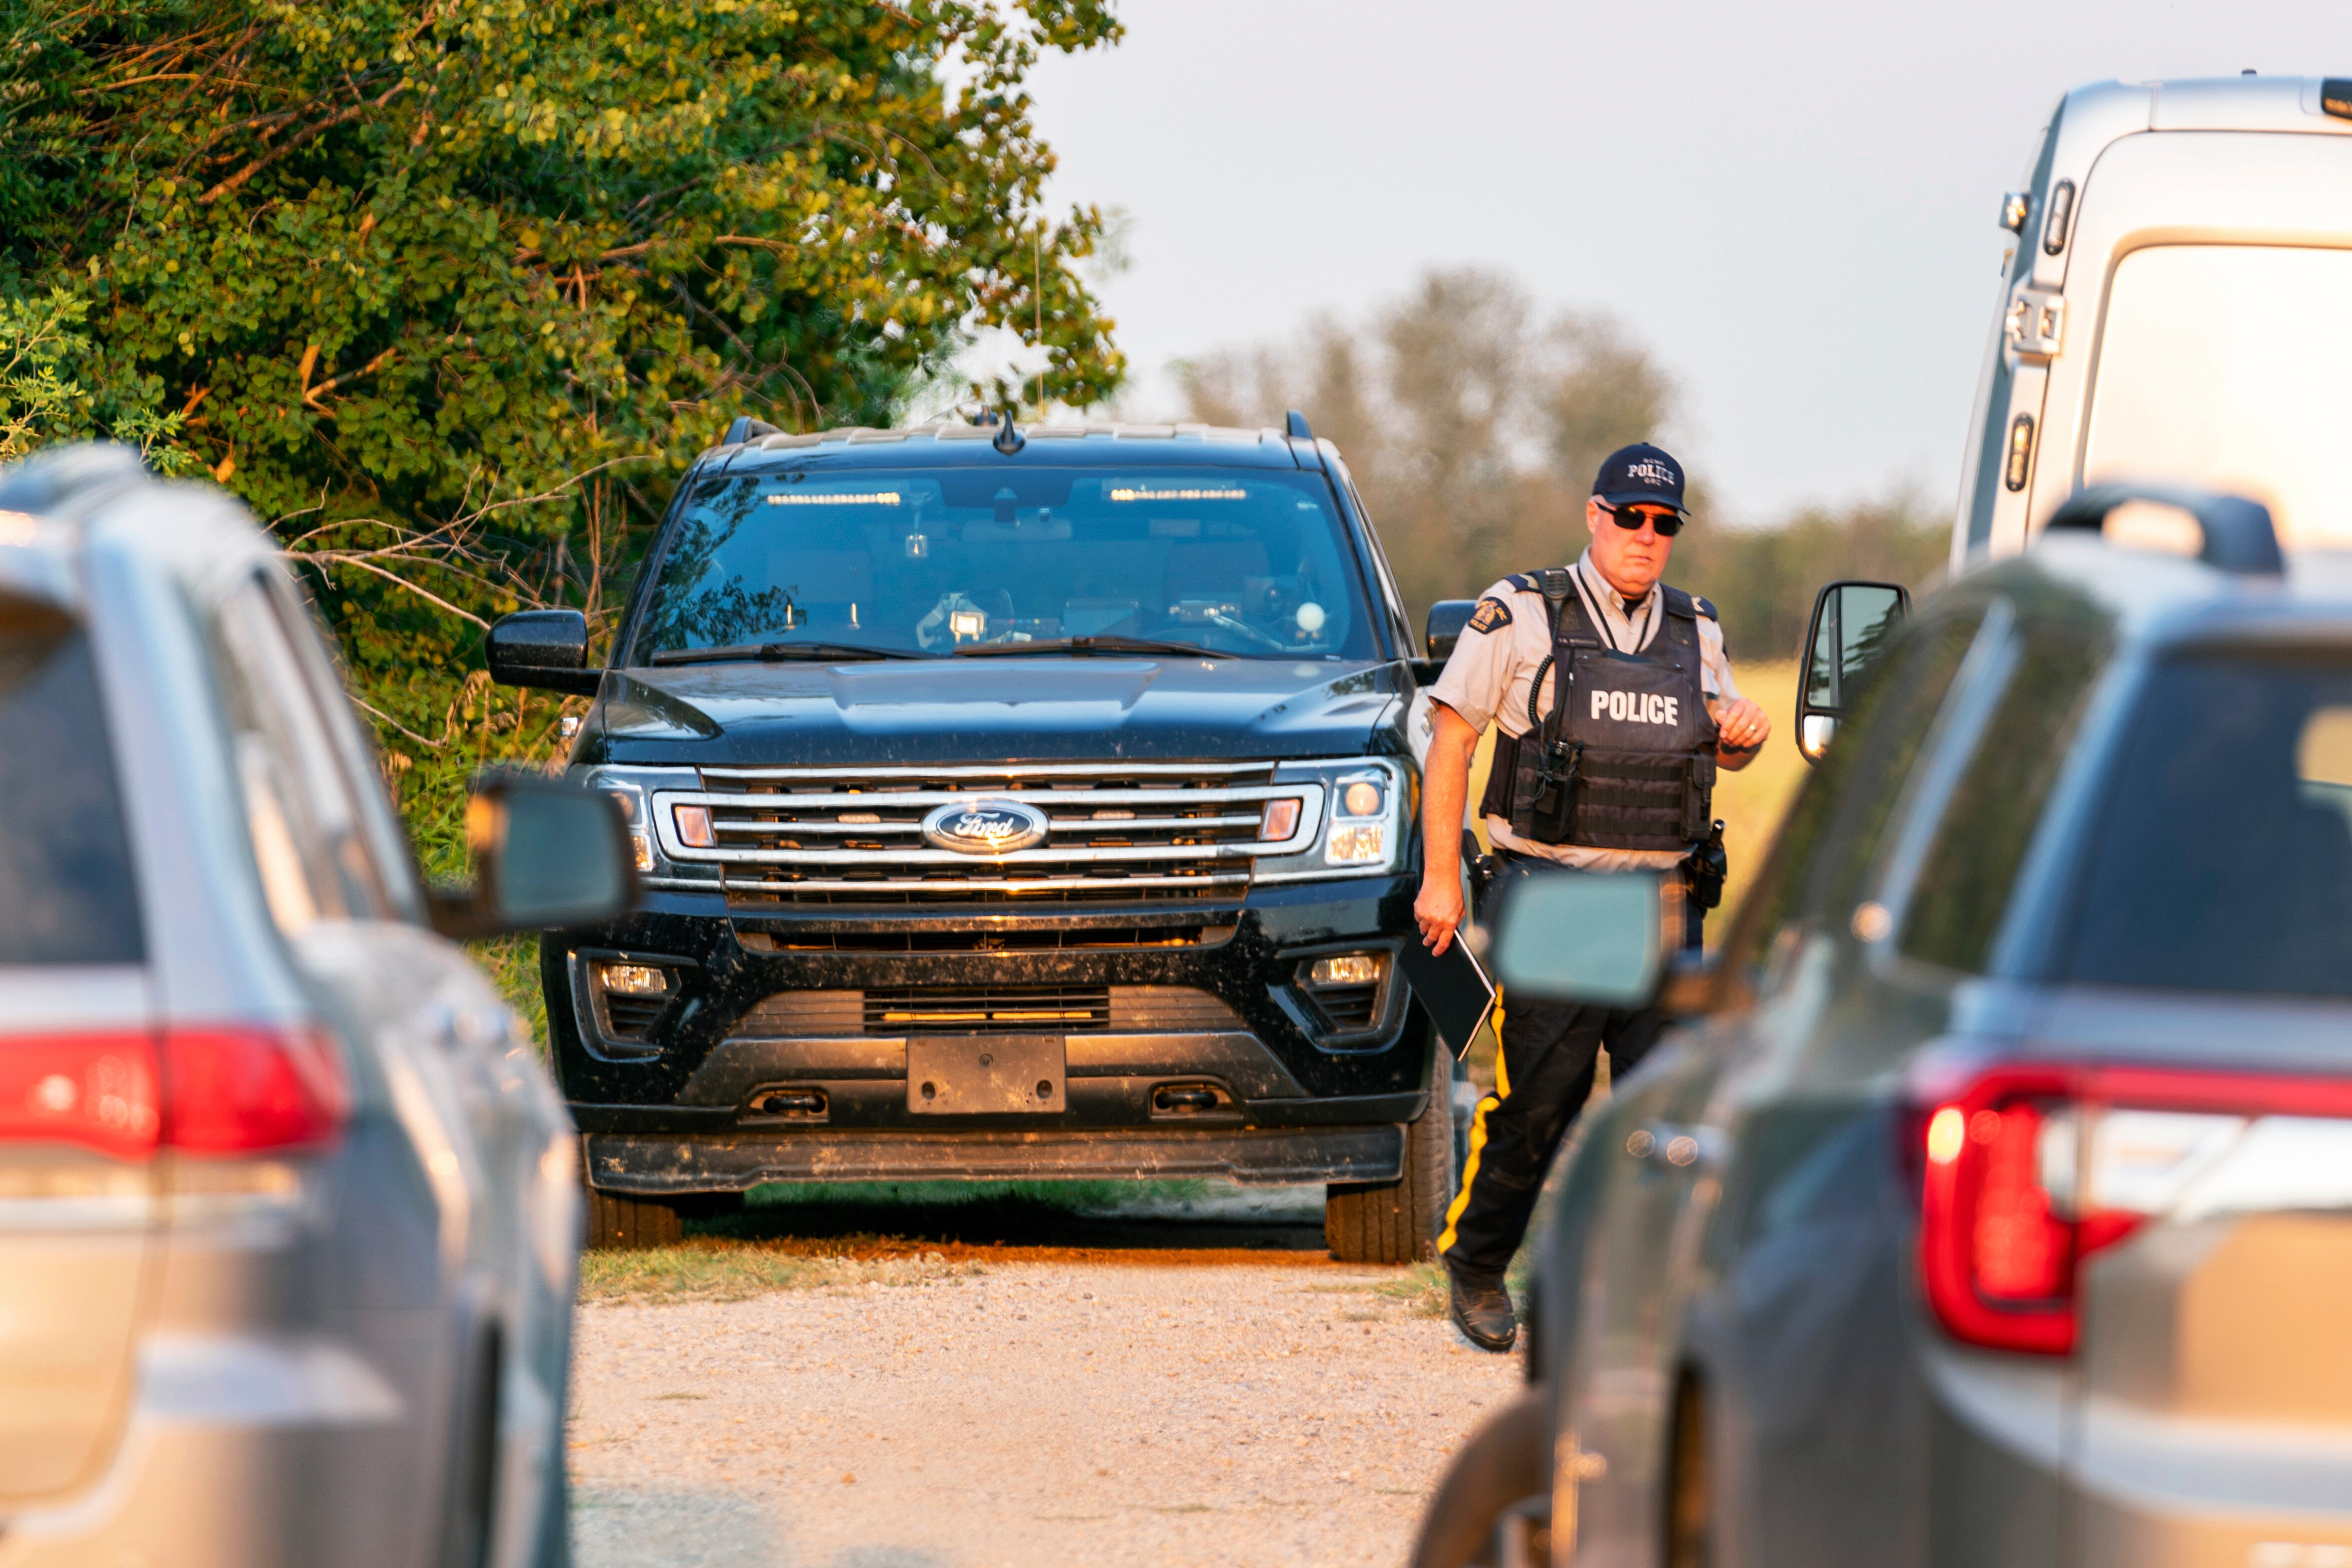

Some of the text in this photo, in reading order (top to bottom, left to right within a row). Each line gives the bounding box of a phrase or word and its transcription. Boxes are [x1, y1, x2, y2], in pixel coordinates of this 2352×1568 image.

[1627, 464, 1675, 486] POLICE
[1591, 690, 1678, 726] POLICE
[955, 812, 1014, 838] Ford
